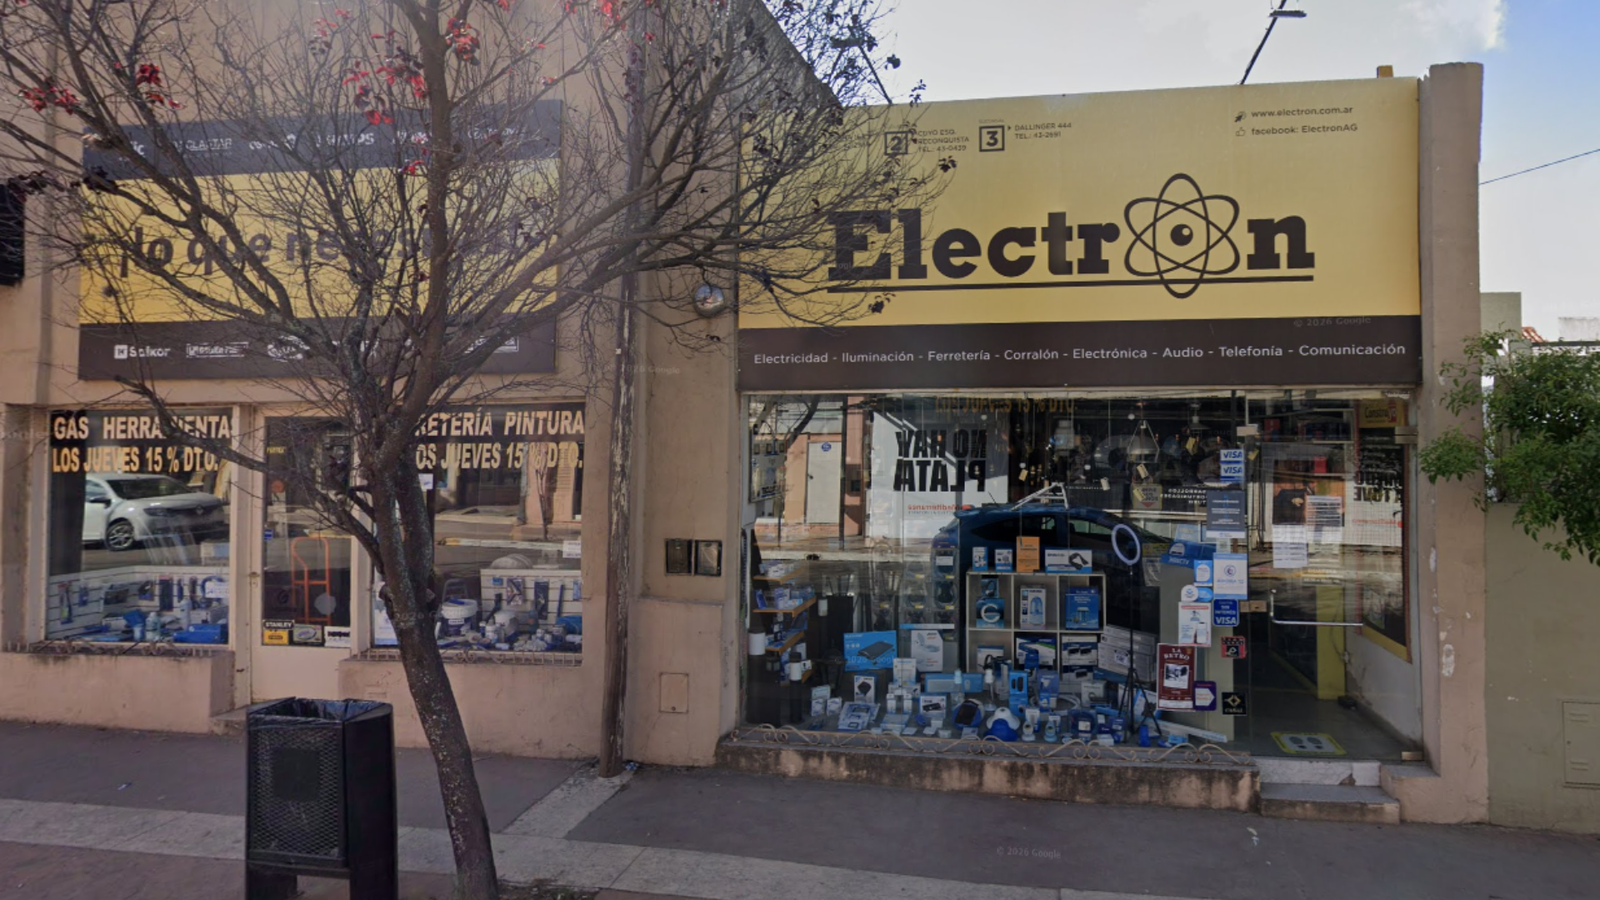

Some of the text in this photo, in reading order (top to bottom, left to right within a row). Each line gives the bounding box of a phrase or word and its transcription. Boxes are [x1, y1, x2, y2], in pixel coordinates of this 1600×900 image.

[1251, 106, 1353, 118] www.electron.com.ar
[1015, 123, 1056, 132] DALLINGER
[1251, 123, 1358, 136] facebook: ElectronAG
[890, 136, 902, 151] 2
[986, 130, 998, 147] 3
[754, 343, 1406, 364] Electricidad Iluminación Ferretería Corralón Electrónica Audio Telefonía Comunicación
[53, 416, 90, 440] GAS
[504, 409, 585, 436] PINTURA
[52, 446, 219, 473] LOS JUEVES 15 % DTO.
[440, 442, 502, 470] JUEVES
[506, 442, 524, 469] 15
[1223, 450, 1243, 459] VISA
[1223, 466, 1243, 475] VISA
[265, 620, 293, 629] STANLEY
[1215, 616, 1237, 625] VISA
